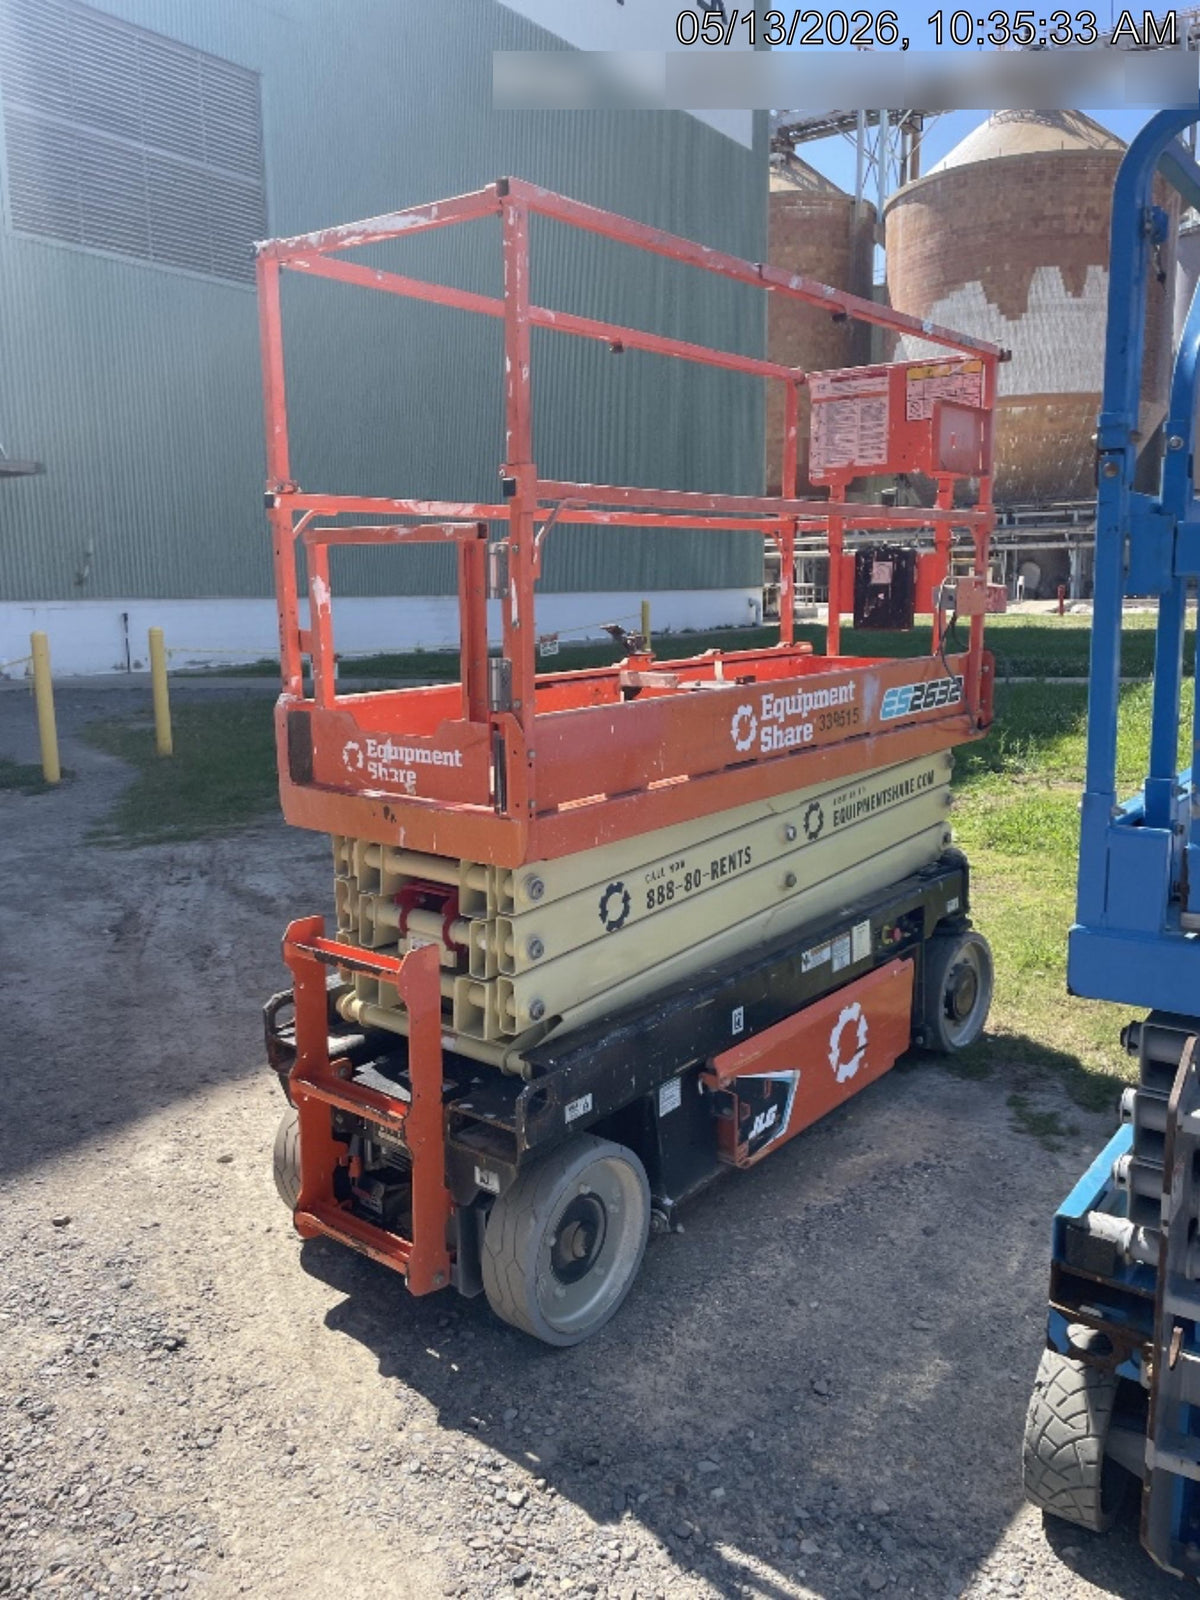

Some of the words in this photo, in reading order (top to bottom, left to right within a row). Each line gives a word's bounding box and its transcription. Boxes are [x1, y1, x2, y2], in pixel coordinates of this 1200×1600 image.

[761, 680, 856, 723] Equipment
[880, 675, 965, 721] ES2632
[366, 738, 463, 768] Equipment
[760, 722, 814, 753] Share
[367, 762, 417, 785] Share
[833, 769, 935, 827] EQUIPMENTSHARE.COM
[646, 845, 752, 910] 888-80-RENTS
[748, 1103, 778, 1140] JLG
